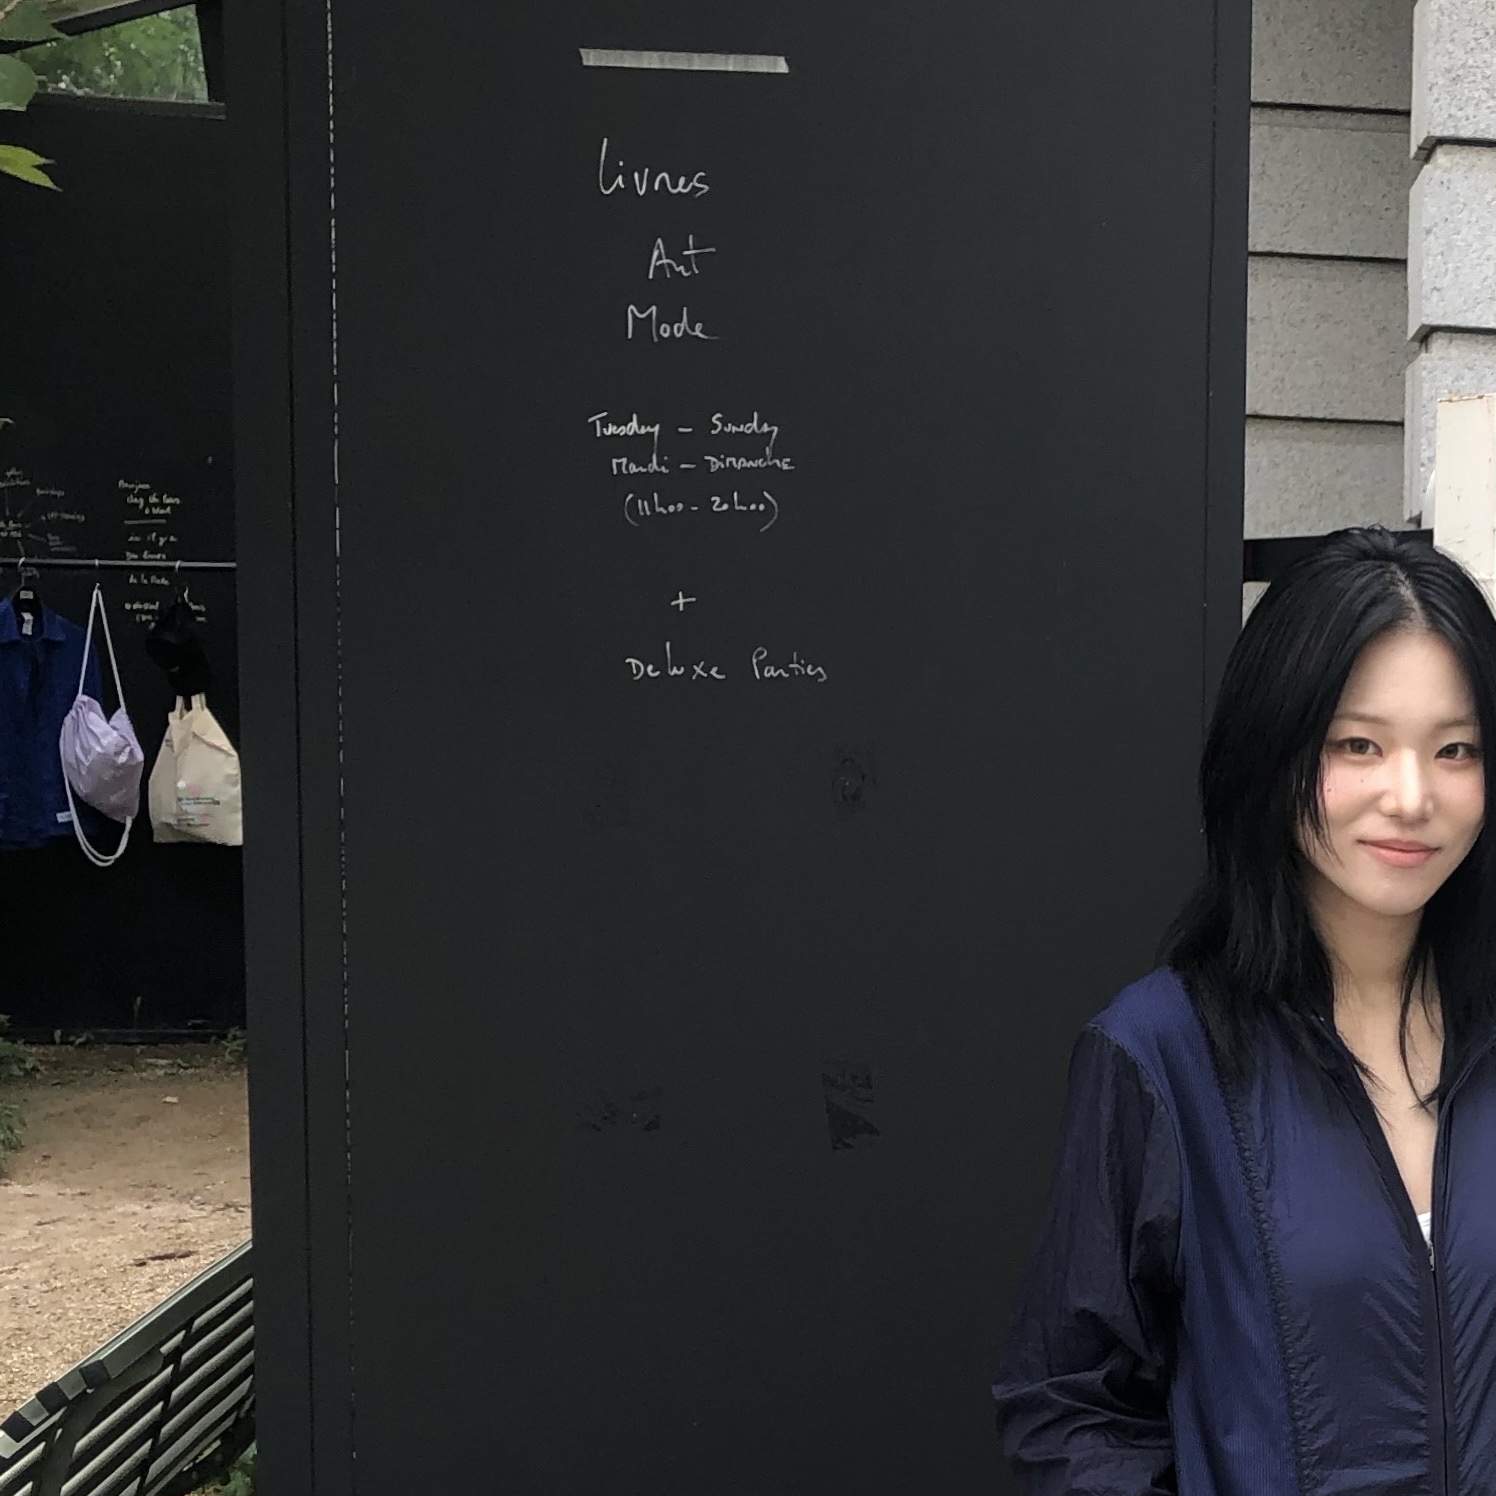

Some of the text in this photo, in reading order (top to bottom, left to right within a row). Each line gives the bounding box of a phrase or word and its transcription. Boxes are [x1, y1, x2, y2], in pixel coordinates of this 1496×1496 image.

[649, 233, 717, 279] Art
[626, 304, 720, 343] Mode
[587, 411, 661, 454] Tuesday
[710, 410, 779, 454] Sunday
[612, 452, 670, 475] Mardi
[625, 641, 828, 683] Deluxe Parties
